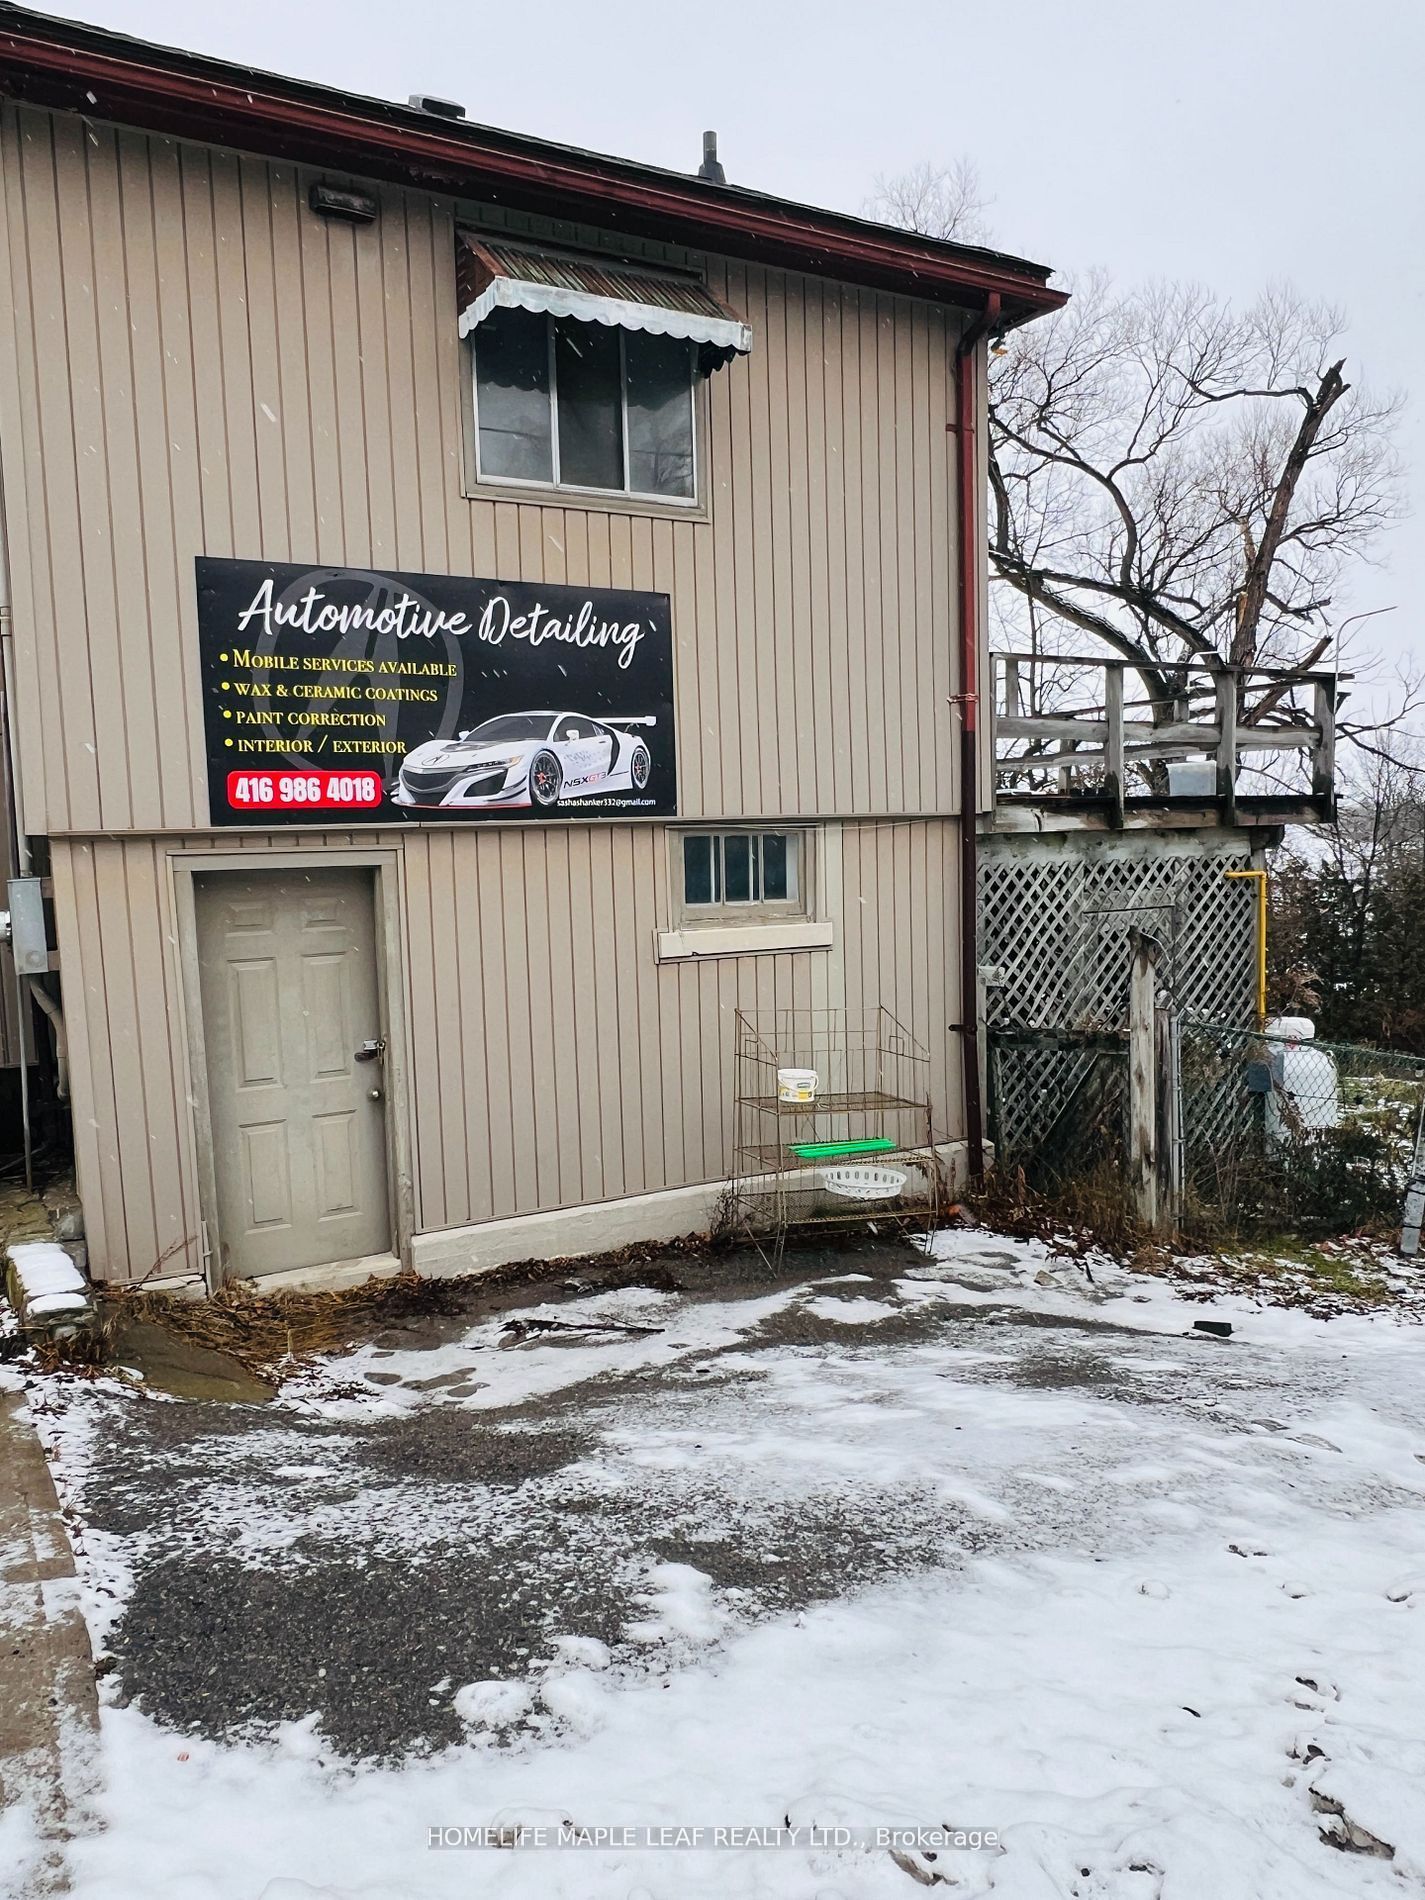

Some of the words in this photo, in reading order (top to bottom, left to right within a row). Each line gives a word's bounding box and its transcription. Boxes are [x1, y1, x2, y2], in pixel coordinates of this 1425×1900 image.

[237, 578, 473, 639] Automotive
[478, 596, 646, 670] Detailing
[232, 648, 299, 670] MOBILE
[303, 656, 375, 673] SERVICES
[378, 661, 457, 677] AVAILABLE
[234, 682, 272, 697] WAX
[276, 684, 288, 697] &
[292, 685, 361, 699] CERAMIC
[365, 687, 438, 702] COATINGS
[236, 711, 283, 725] PAINT
[287, 712, 386, 727] CORRECTION
[238, 739, 314, 753] INTERIOR
[332, 740, 407, 754] EXTERIOR
[235, 777, 274, 802] 416
[279, 777, 321, 802] 986
[326, 777, 375, 801] 4018
